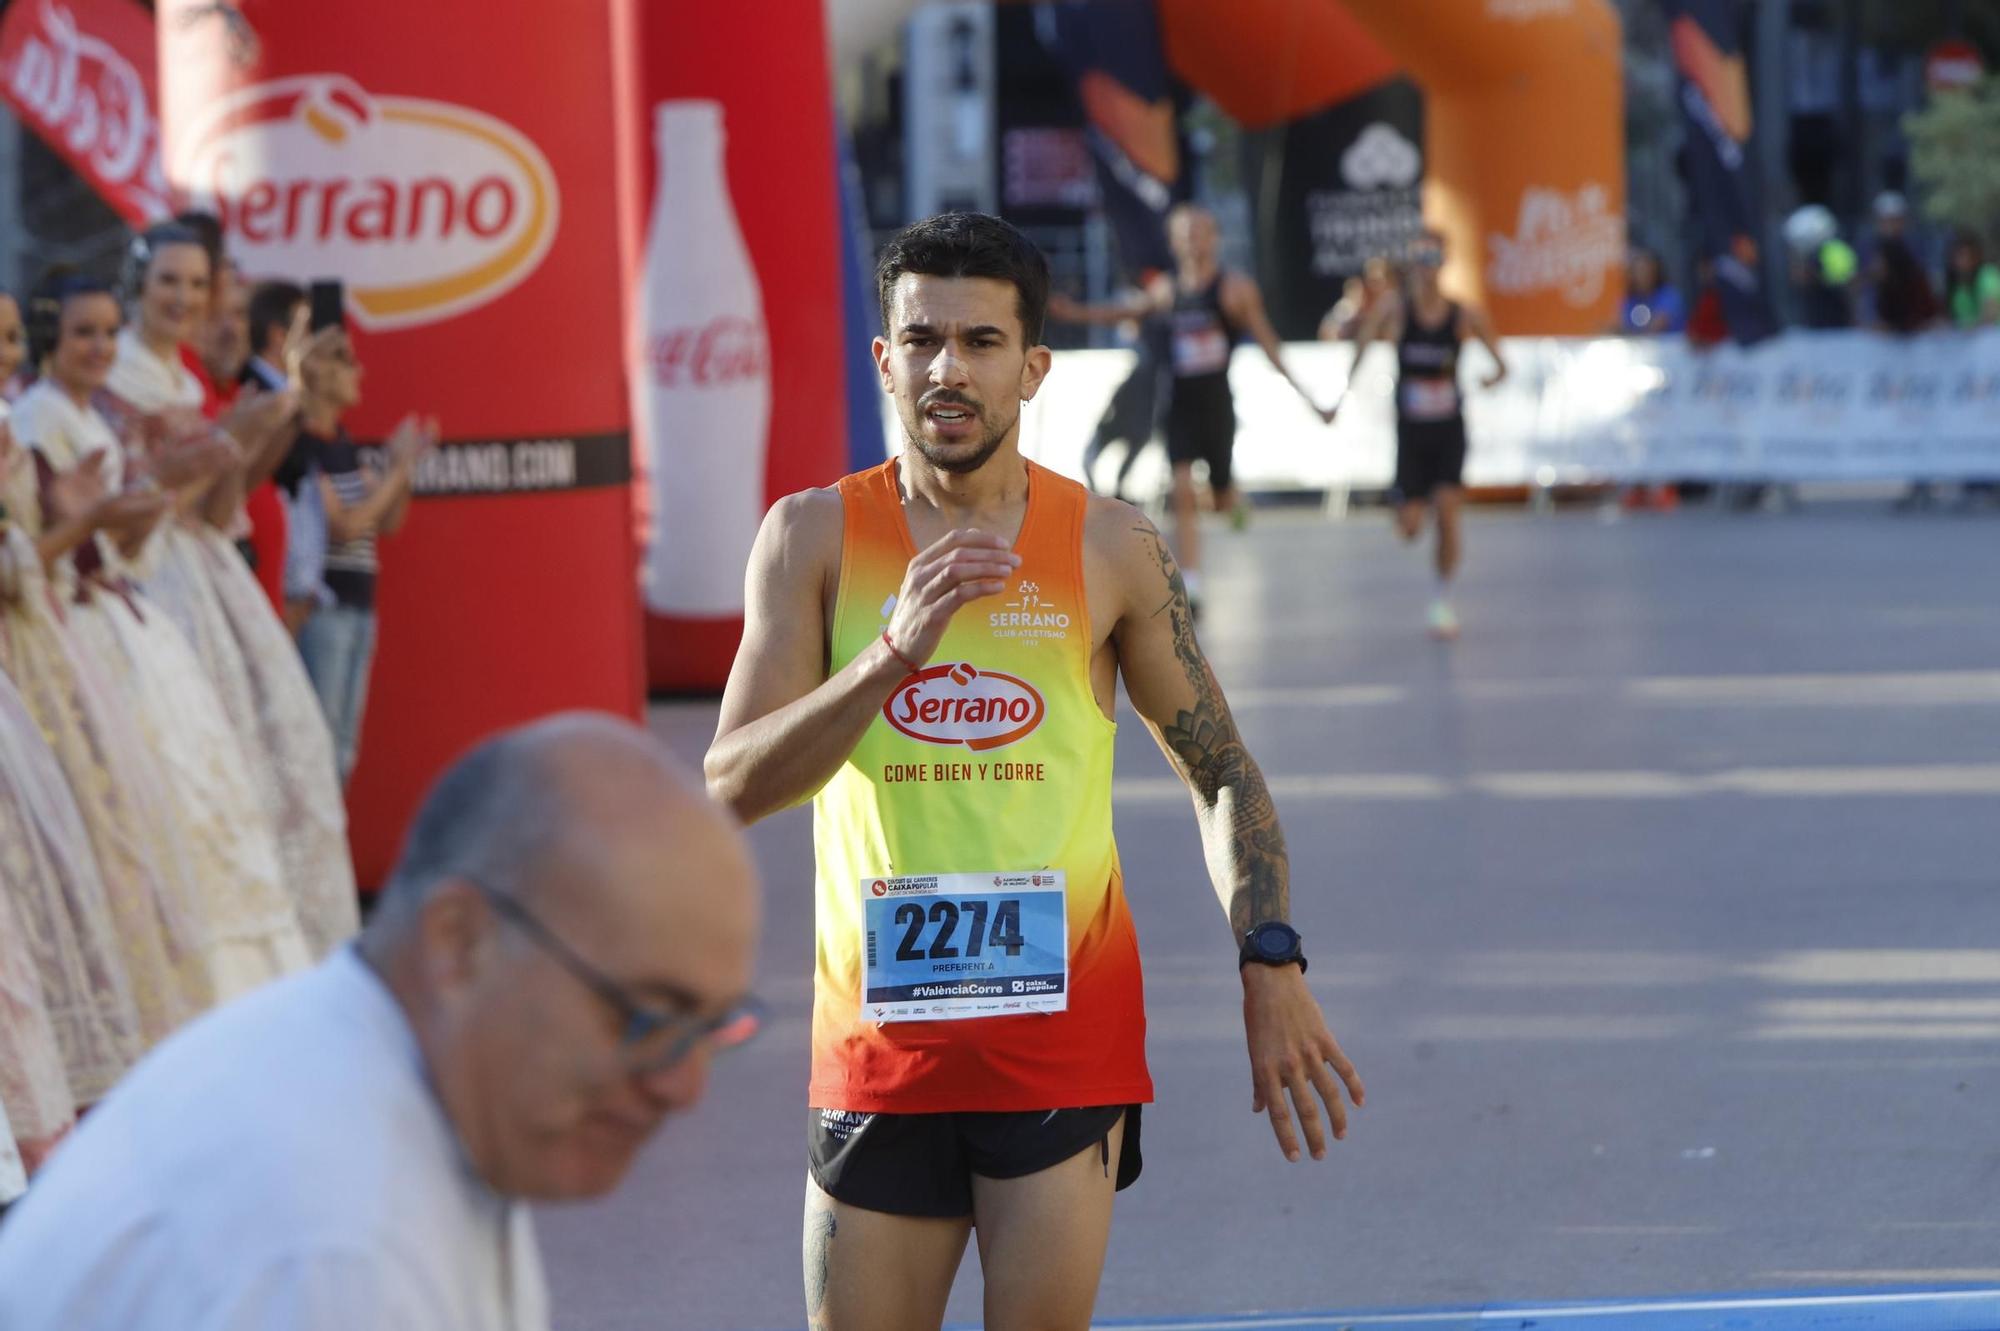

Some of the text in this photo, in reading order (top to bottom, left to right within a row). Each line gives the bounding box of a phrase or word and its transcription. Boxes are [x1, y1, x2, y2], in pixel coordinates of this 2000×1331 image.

[990, 612, 1070, 628] SERRANO
[993, 629, 1066, 639] CLUB ATLETISMO
[898, 687, 1030, 724] Serrano
[884, 763, 1045, 783] COME BIEN Y CORRE
[894, 900, 1025, 962] 2274
[932, 962, 995, 973] PREFERENT A
[912, 984, 1003, 997] #ValènciaCorre
[1025, 984, 1058, 992] popular
